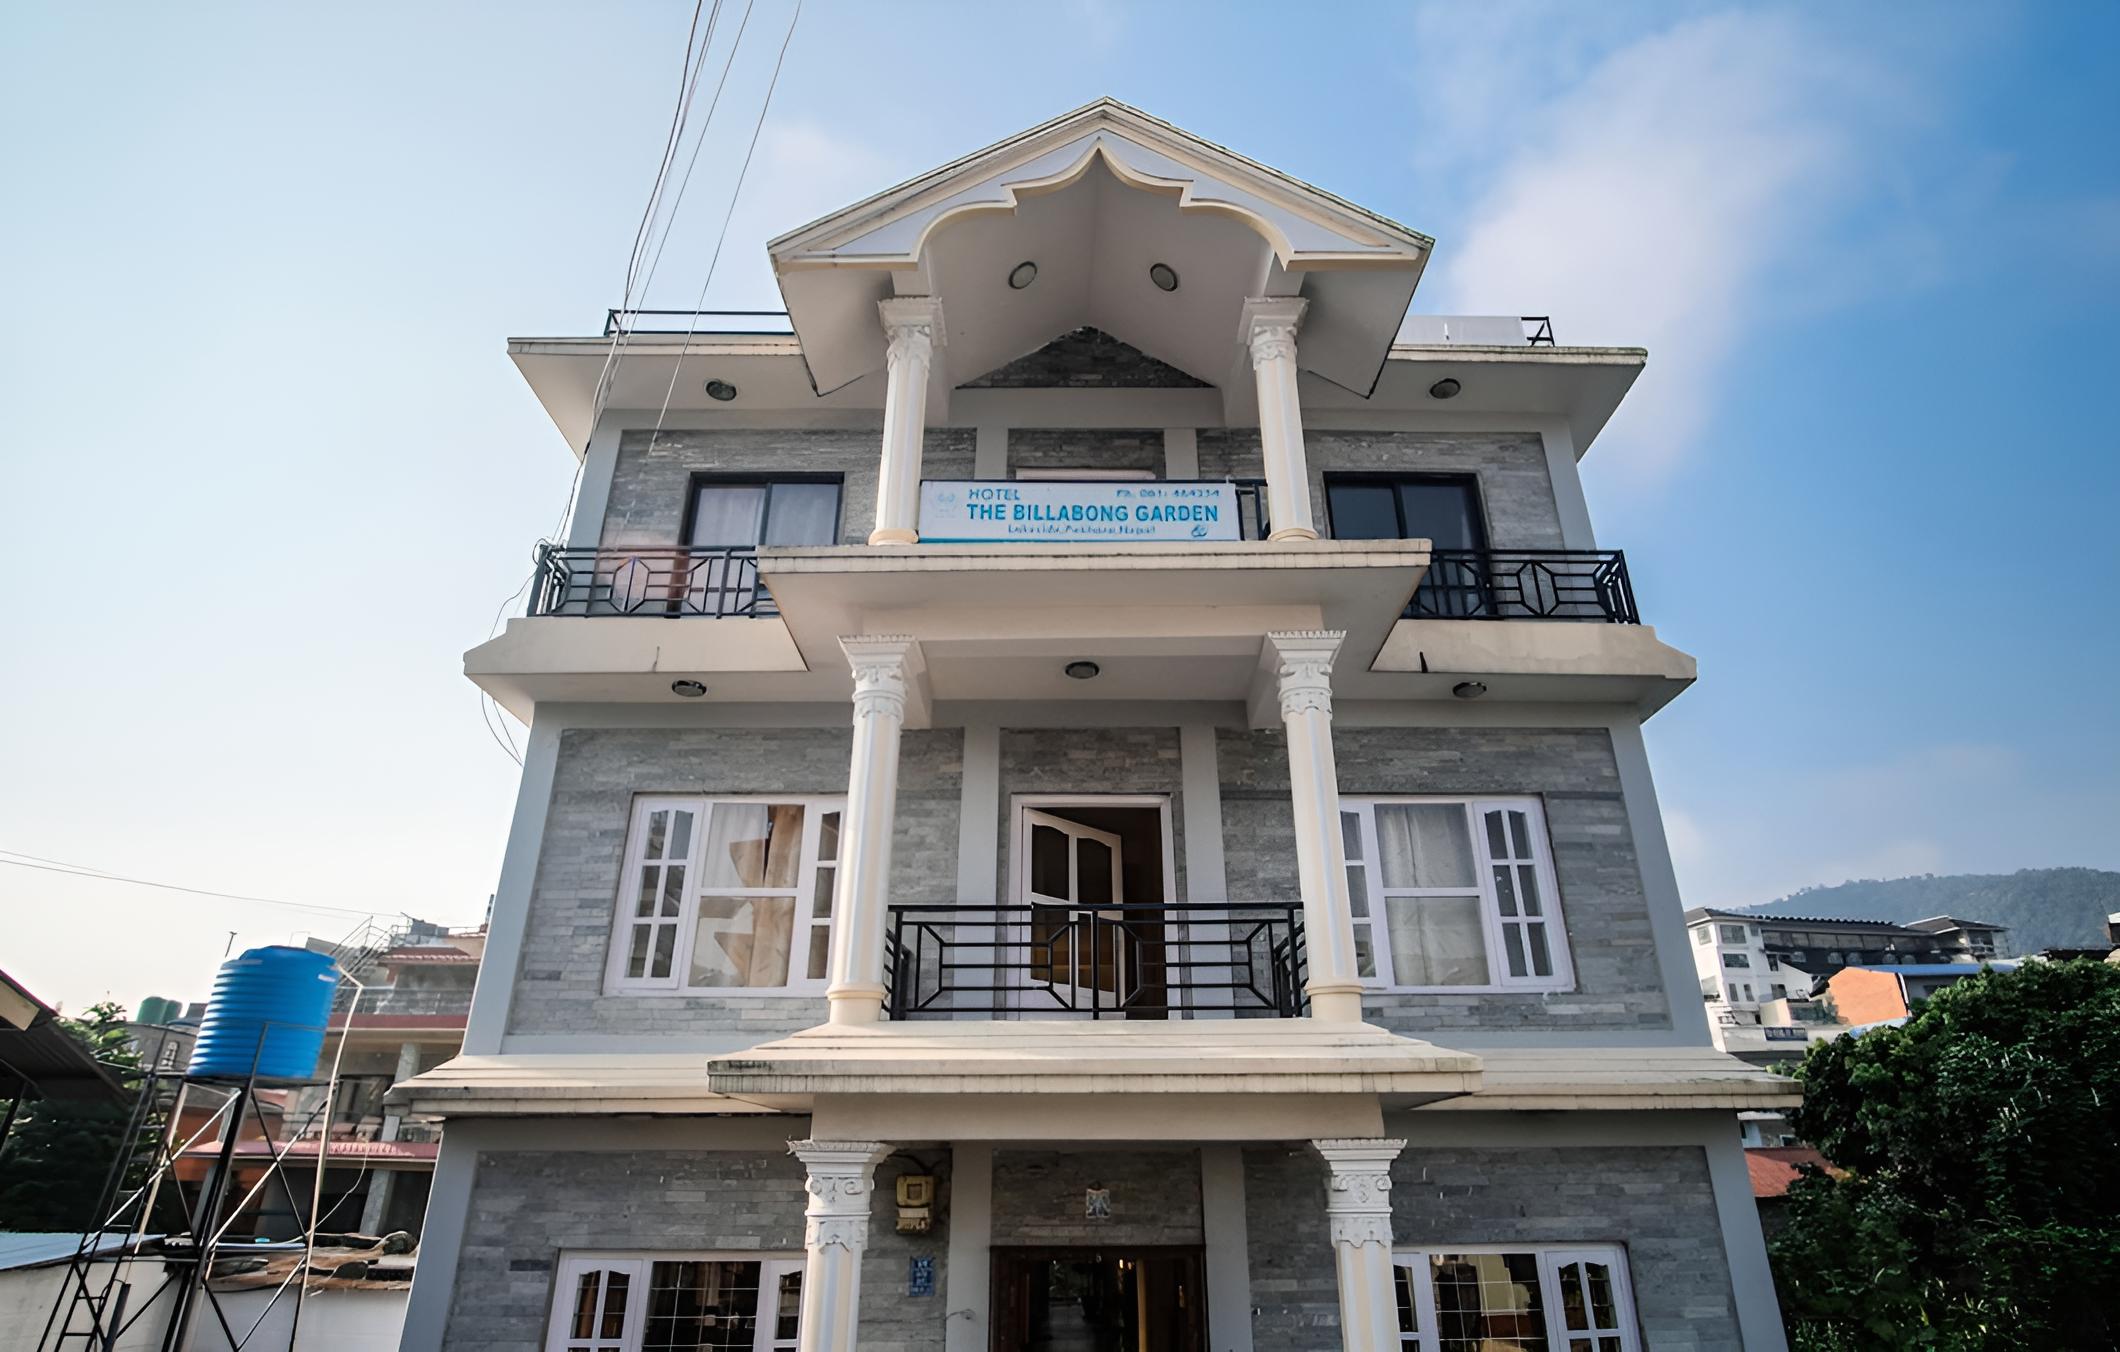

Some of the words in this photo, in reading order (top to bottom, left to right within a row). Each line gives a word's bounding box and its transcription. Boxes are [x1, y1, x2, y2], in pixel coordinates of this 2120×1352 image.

[968, 488, 1020, 501] HOTEL
[966, 503, 1006, 520] THE
[1013, 504, 1129, 521] BILLABONG
[1135, 504, 1218, 521] GARDEN
